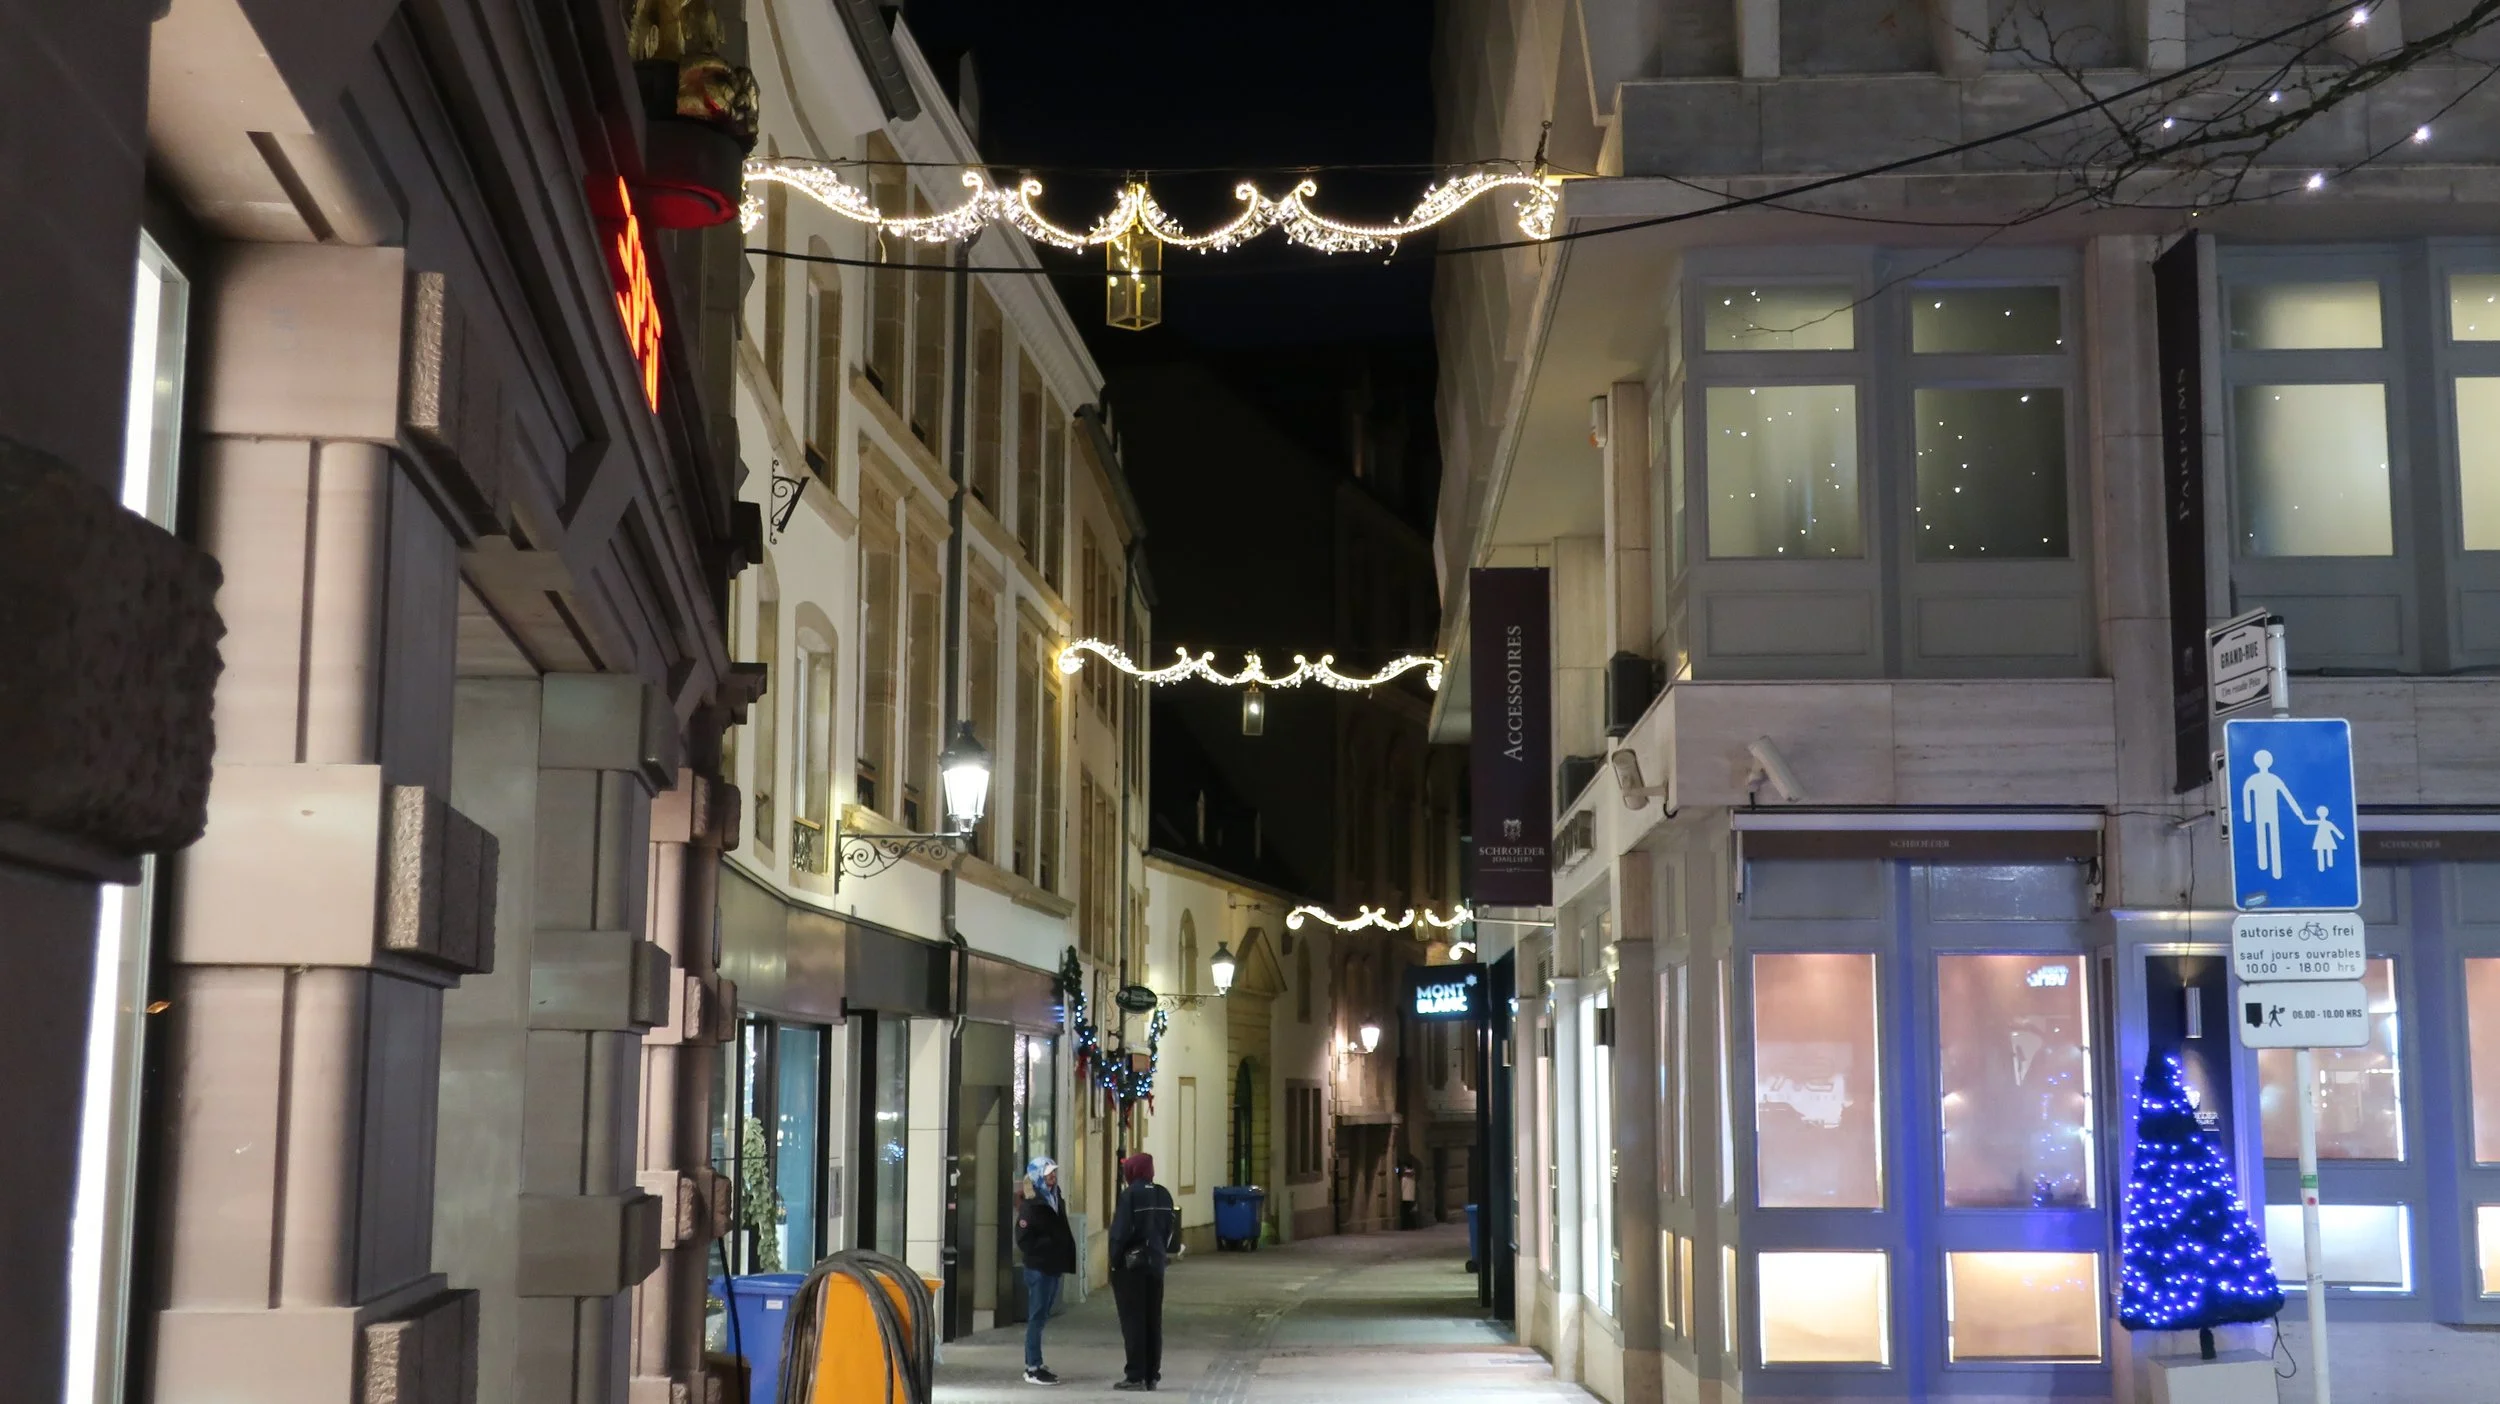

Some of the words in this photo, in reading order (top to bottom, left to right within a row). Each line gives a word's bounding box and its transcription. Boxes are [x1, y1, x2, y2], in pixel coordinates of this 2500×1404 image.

[2220, 641, 2258, 669] GRAND-RUE
[1503, 624, 1523, 762] ACCESSOIRES
[1479, 846, 1545, 856] SCHROEDER
[1888, 839, 1951, 849] SCHROEDER
[2240, 926, 2293, 938] autorisé
[2332, 924, 2354, 936] frei
[2240, 949, 2264, 960] sauf
[2271, 949, 2300, 962] jours
[2306, 948, 2361, 960] ouvrables
[2246, 963, 2277, 974] 10.00
[2299, 962, 2330, 973] 18.00
[2337, 961, 2356, 973] hrs
[1416, 983, 1466, 999] MONT
[1416, 995, 1468, 1014] BLANC
[2322, 1009, 2345, 1019] 10.00
[2346, 1008, 2363, 1018] HRS
